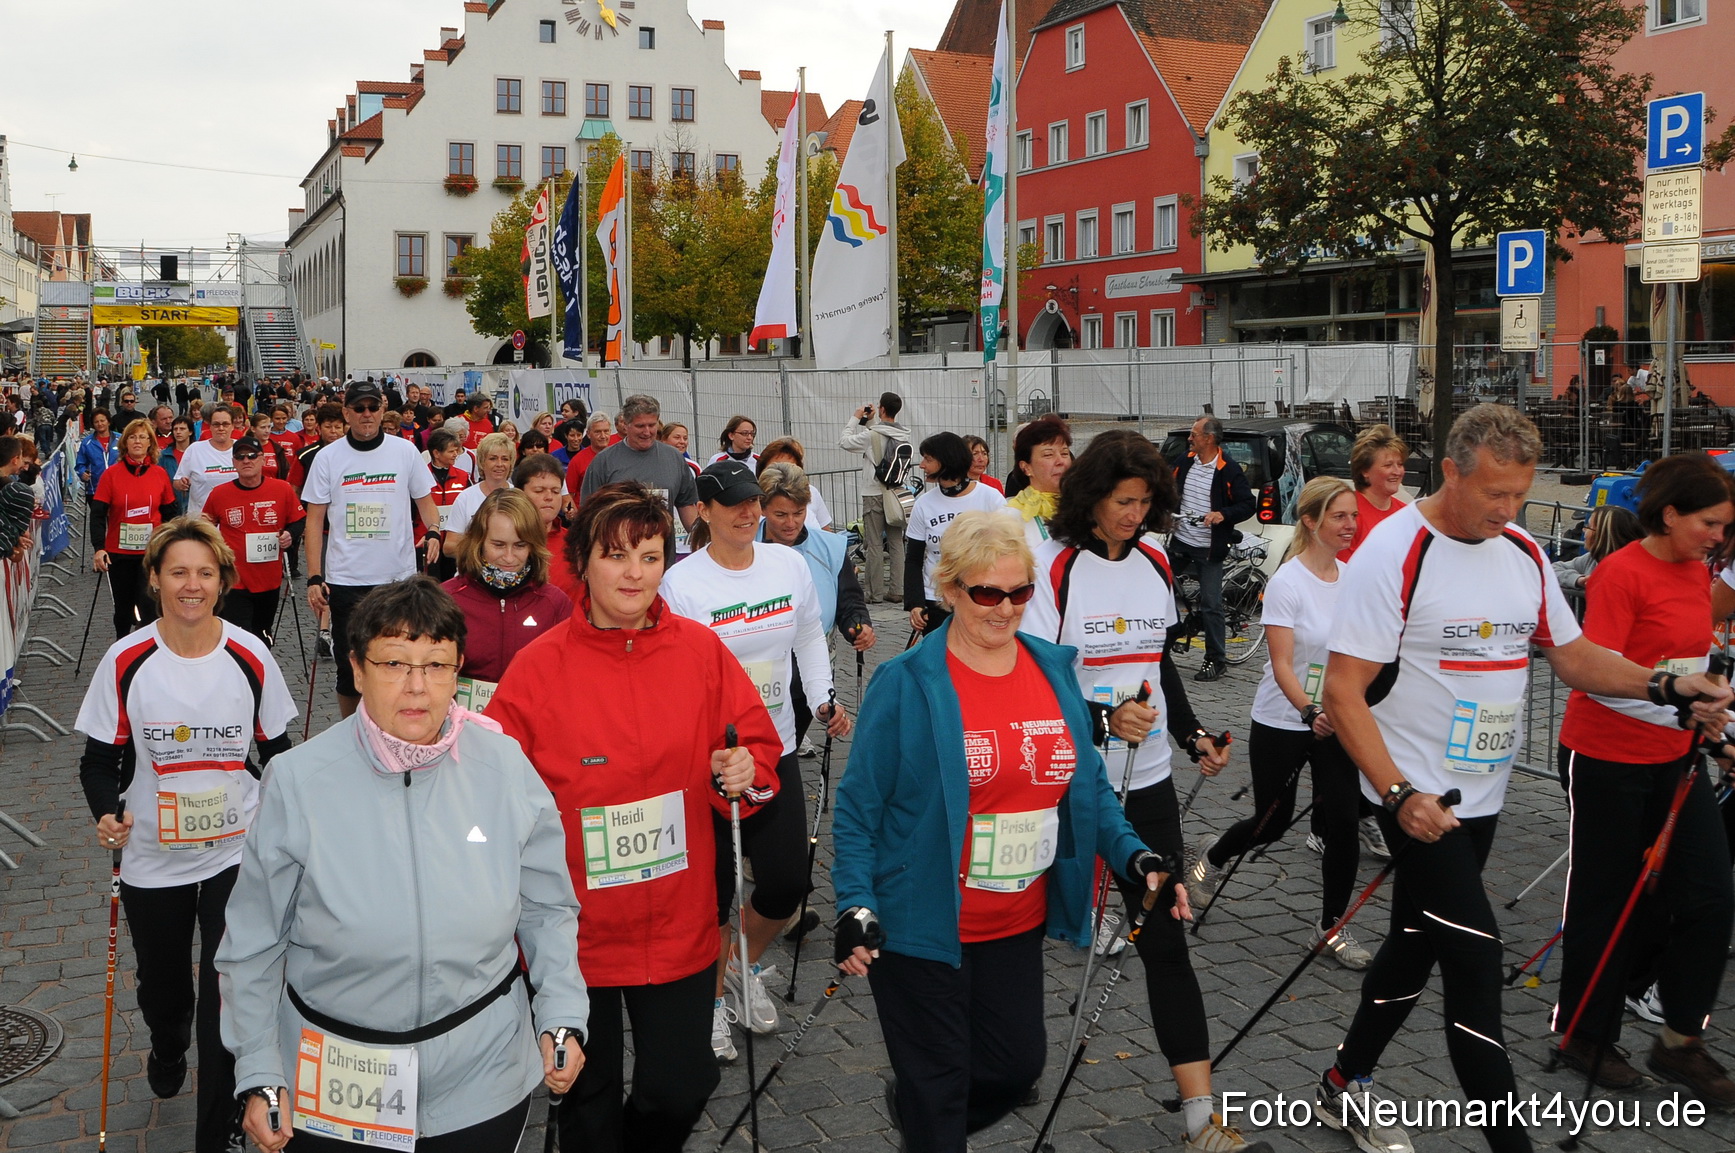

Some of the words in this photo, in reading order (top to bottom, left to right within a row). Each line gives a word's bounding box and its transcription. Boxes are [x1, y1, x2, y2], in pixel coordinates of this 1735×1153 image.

[1659, 105, 1691, 159] P
[1656, 179, 1672, 188] nur
[1675, 174, 1690, 186] mit
[1649, 186, 1697, 200] Parkschein
[1652, 198, 1693, 211] werktags
[1647, 228, 1656, 236] Sa
[1507, 239, 1534, 288] P
[116, 286, 172, 299] BOCK
[206, 289, 239, 298] PFLEIDERER
[1108, 279, 1138, 295] Gasthaus
[141, 309, 191, 321] START
[358, 516, 387, 527] 8097
[930, 511, 963, 527] BER
[128, 533, 150, 542] 8082
[257, 543, 277, 553] 8104
[747, 597, 791, 620] ITALIA
[1022, 727, 1065, 737] STADTLAUF
[1475, 729, 1516, 752] 8026
[180, 792, 228, 809] Theresia
[184, 807, 239, 832] 8036
[611, 808, 645, 828] Heidi
[1000, 818, 1036, 835] Priska
[214, 833, 246, 846] PFLEIDERER
[616, 823, 676, 858] 8071
[1000, 838, 1050, 866] 8013
[652, 857, 686, 873] PFLEIDERER
[327, 1045, 398, 1077] Christina
[327, 1078, 407, 1116] 8044
[366, 1130, 414, 1145] PFLEIDERER
